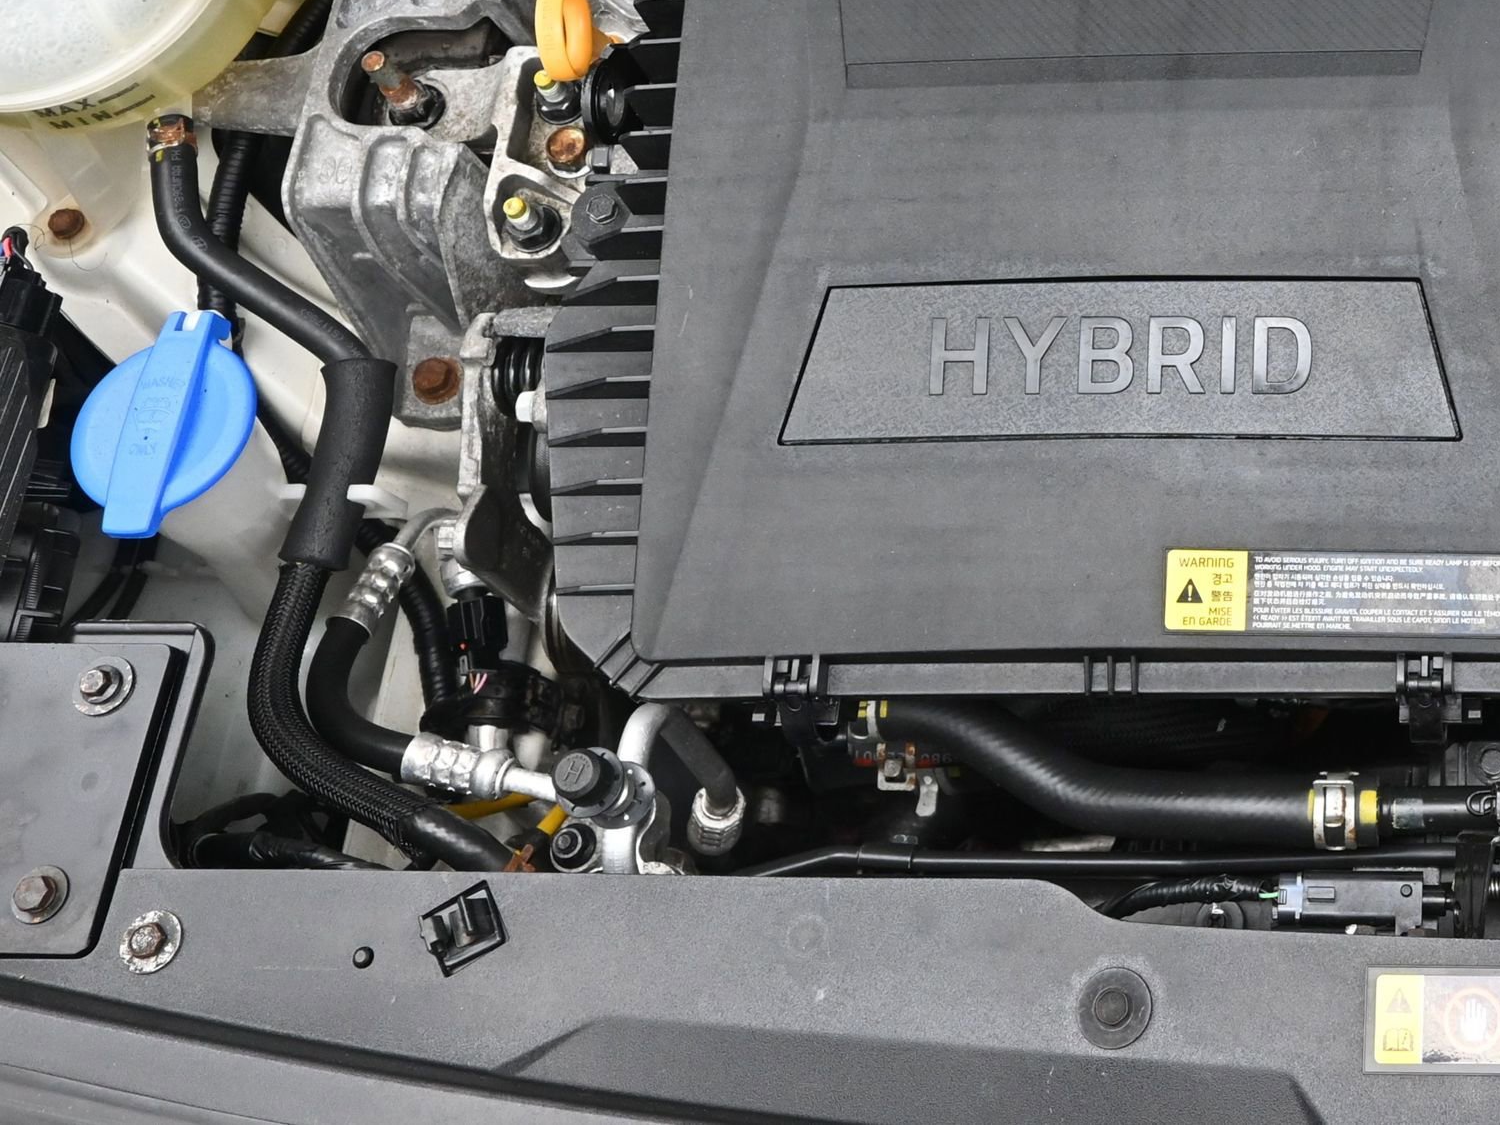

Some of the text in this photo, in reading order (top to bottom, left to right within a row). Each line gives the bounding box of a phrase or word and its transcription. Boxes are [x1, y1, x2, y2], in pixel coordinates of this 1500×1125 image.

[32, 98, 96, 118] MAX
[48, 110, 113, 130] MIN
[928, 315, 1313, 396] HYBRID
[1179, 557, 1235, 569] WARNING
[1212, 573, 1233, 586] 경고
[1208, 606, 1233, 616] MISE
[1182, 616, 1232, 626] EN GARDE
[562, 760, 586, 784] H
